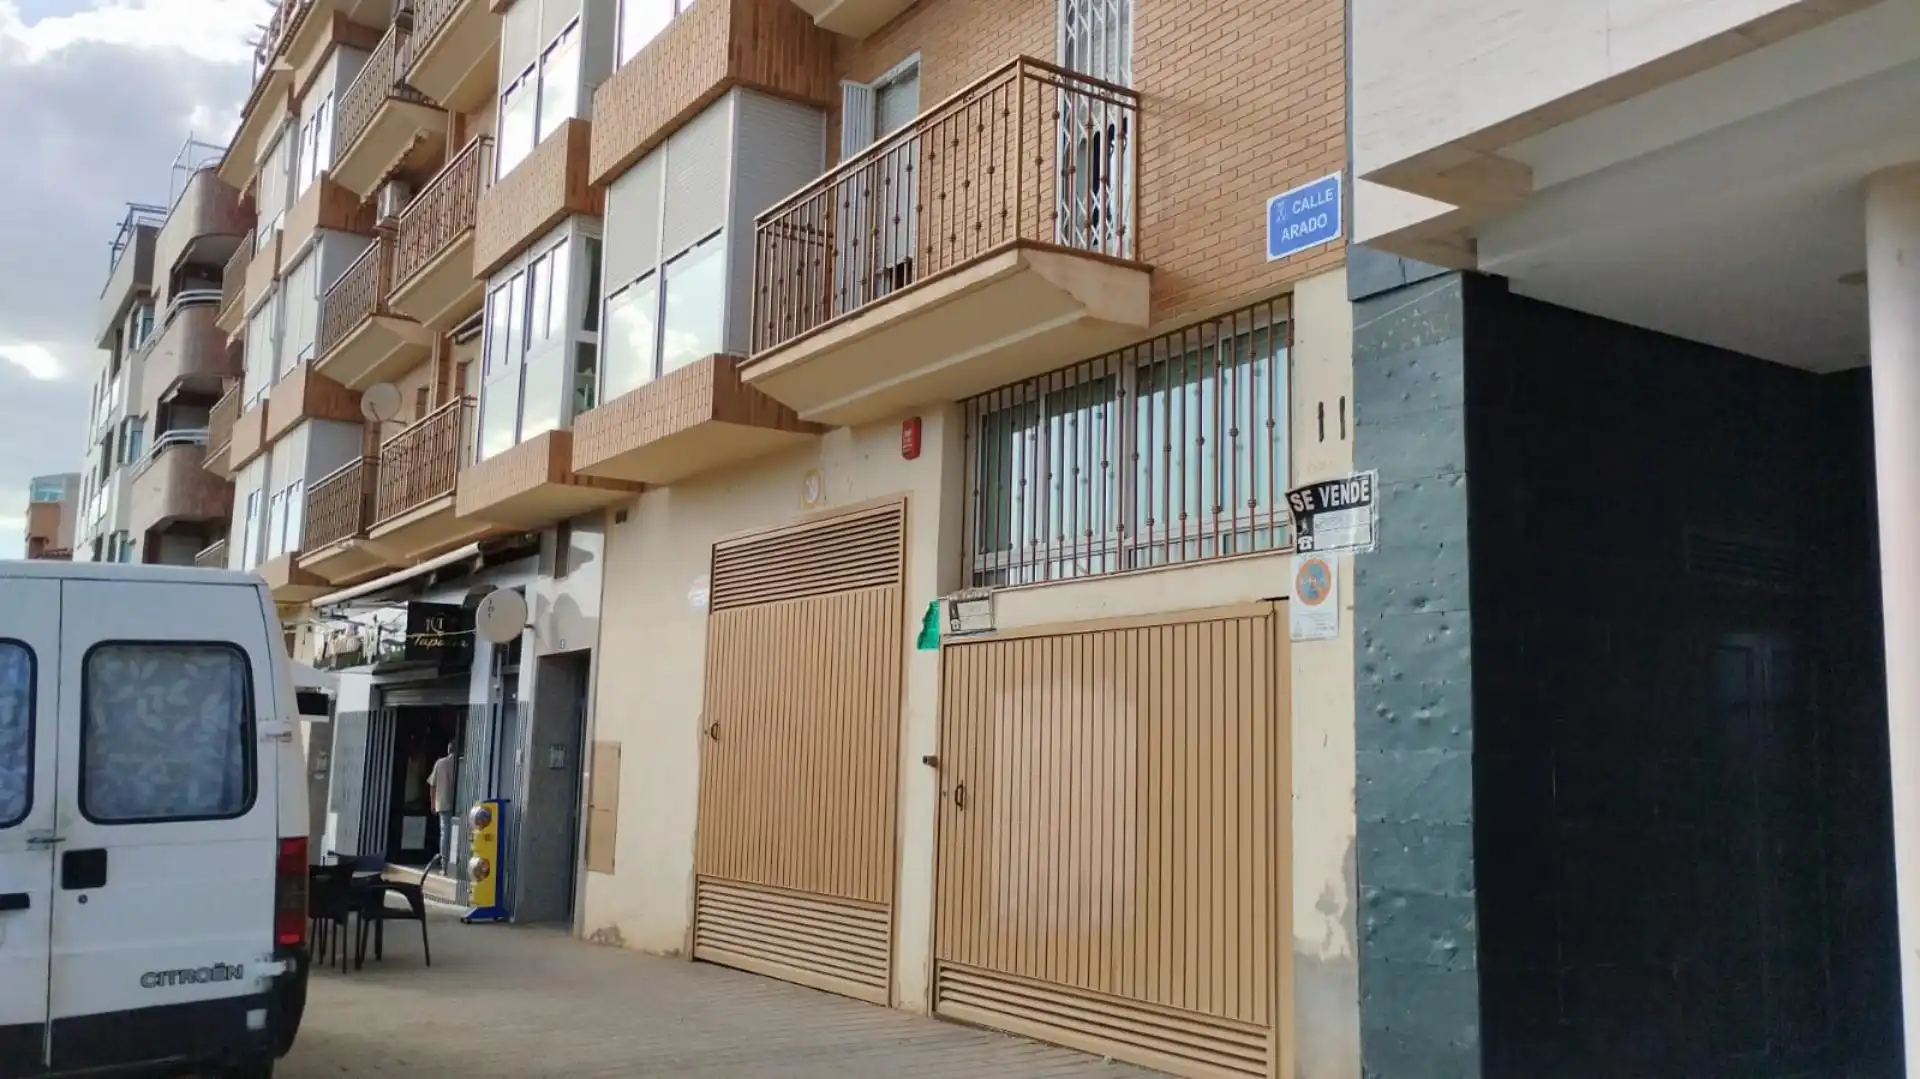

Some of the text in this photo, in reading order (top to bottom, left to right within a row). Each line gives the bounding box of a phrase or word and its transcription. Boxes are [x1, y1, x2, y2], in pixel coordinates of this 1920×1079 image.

[1292, 187, 1334, 213] CALLE
[1281, 213, 1328, 242] ARADO
[1290, 479, 1370, 512] SE VENDE
[140, 962, 244, 988] CITROËN
